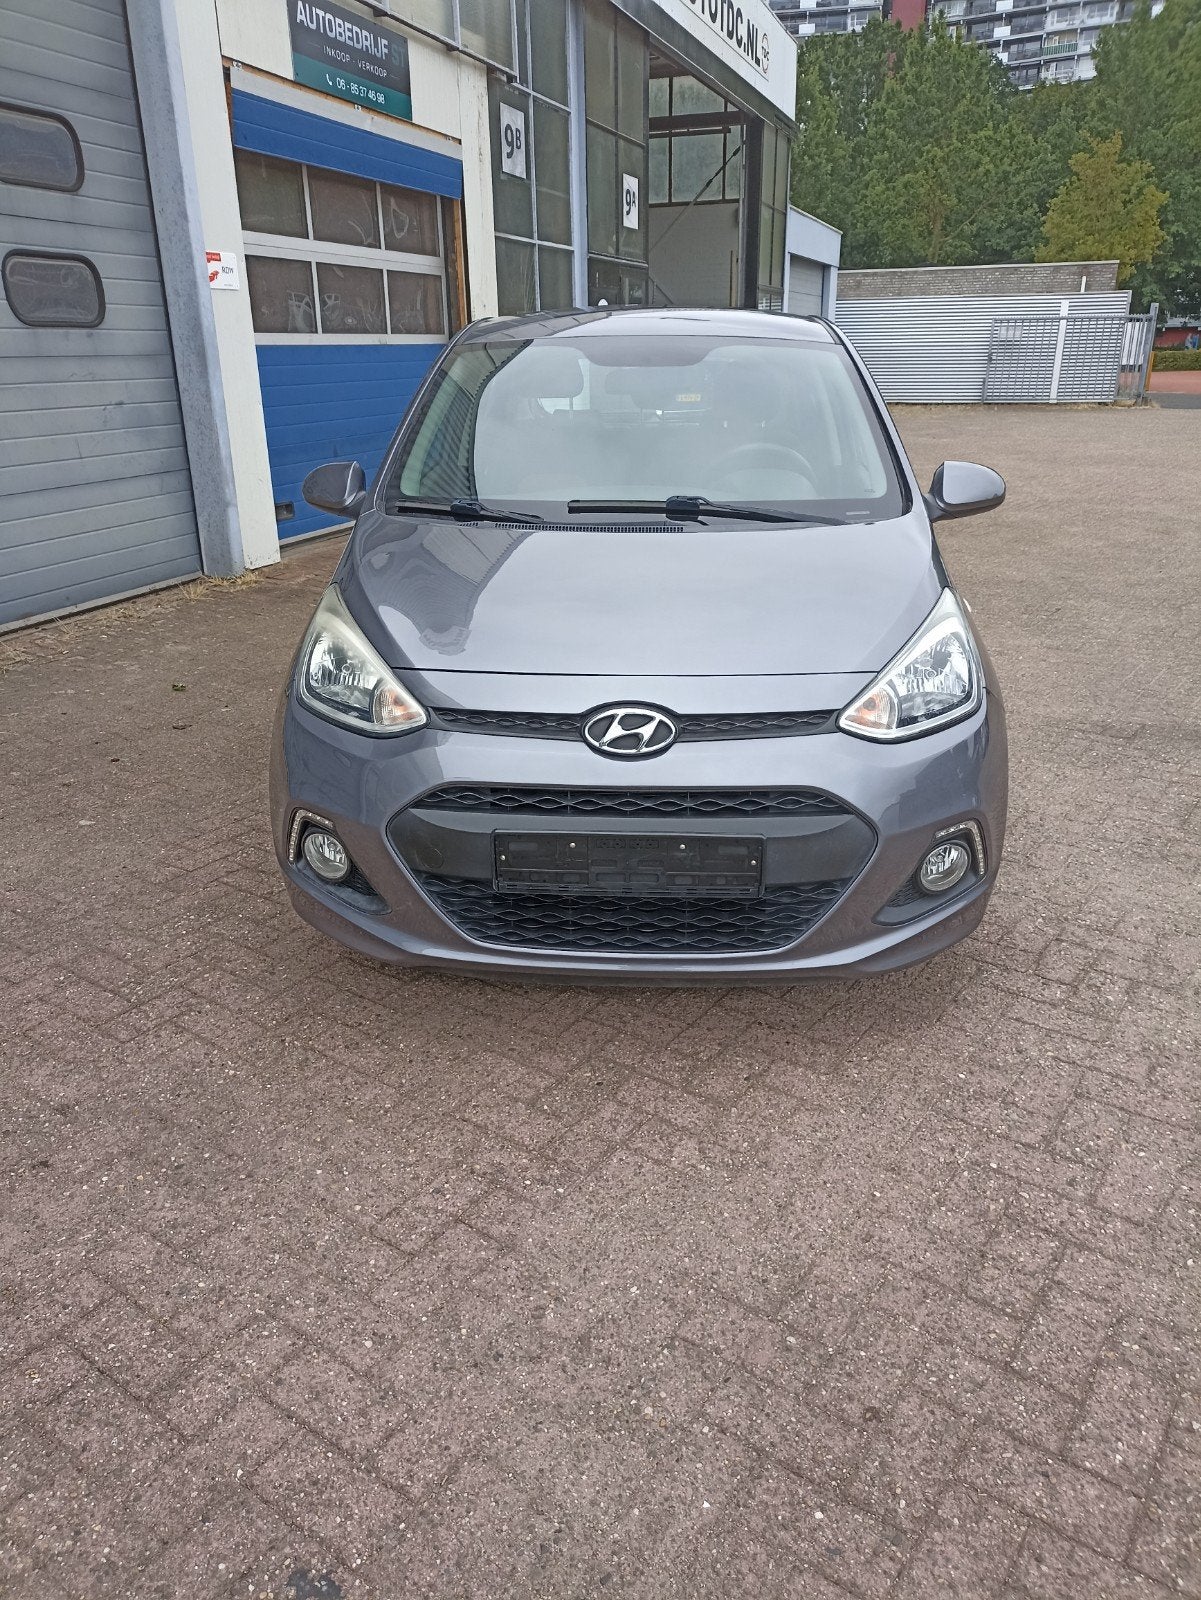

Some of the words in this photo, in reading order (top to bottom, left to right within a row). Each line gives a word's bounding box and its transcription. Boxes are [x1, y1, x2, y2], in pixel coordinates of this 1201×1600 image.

[296, 1, 389, 60] AUTOBEDRIJF
[689, 0, 761, 67] OTDC.NL
[323, 45, 350, 63] INKOOP
[357, 58, 388, 78] VERKOOP
[336, 77, 346, 90] 06
[504, 123, 522, 159] 9B
[625, 188, 637, 216] 9A
